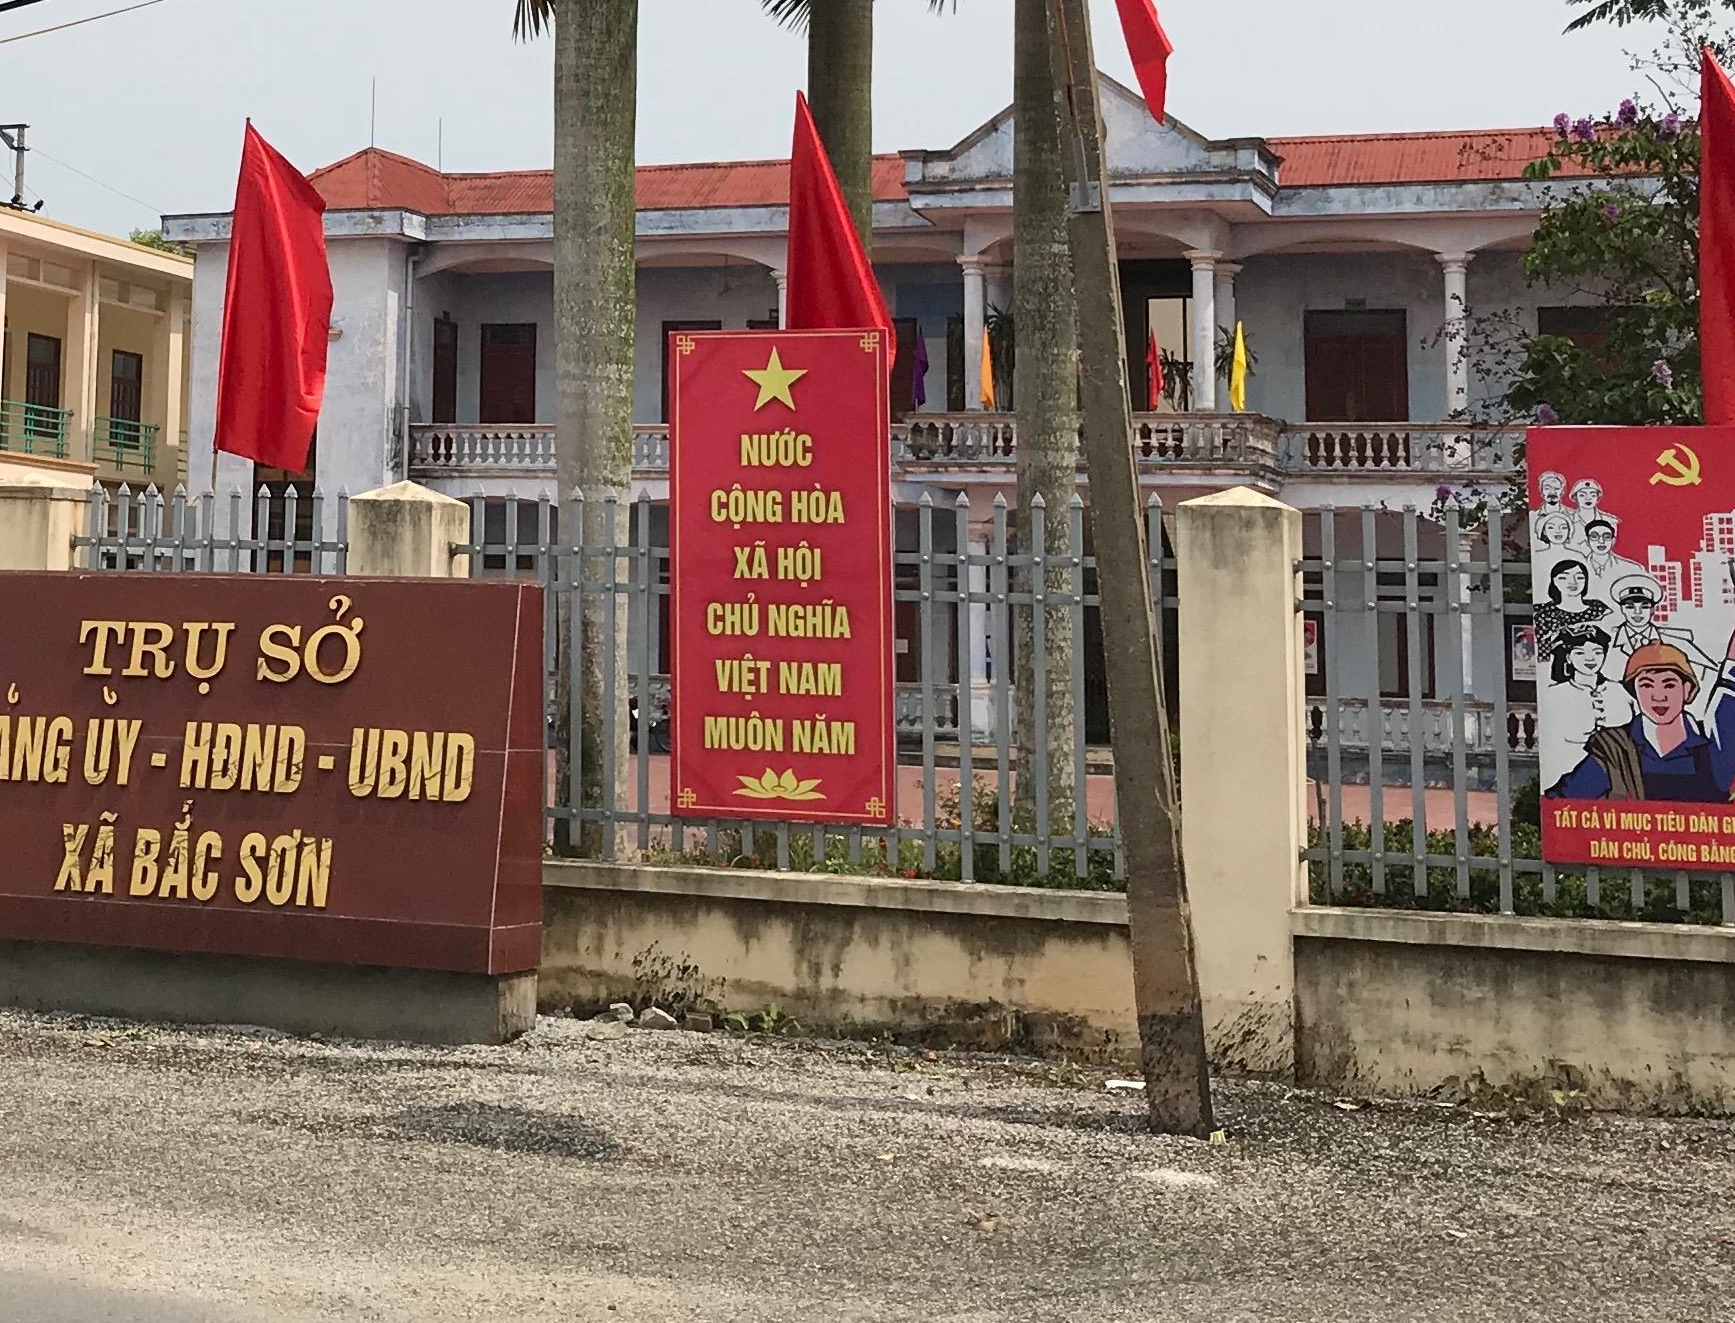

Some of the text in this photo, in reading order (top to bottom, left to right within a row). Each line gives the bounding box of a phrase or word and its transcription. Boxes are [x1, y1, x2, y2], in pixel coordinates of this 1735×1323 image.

[741, 428, 812, 466] NƯỚC
[710, 482, 845, 529] CỘNG HÒA
[734, 541, 821, 588] XÃ HỘI
[707, 592, 851, 639] CHỦ NGHĨA
[79, 594, 364, 695] TRỤ SỞ
[715, 653, 842, 701] VIỆT NAM
[704, 711, 856, 755] MUÔN NĂM
[150, 751, 166, 767] -
[180, 722, 305, 793] HĐND
[318, 755, 334, 770] -
[348, 728, 475, 802] UBND
[1554, 805, 1735, 834] TẤT CẢ VÌ MỤC TIÊU DÂN GI
[53, 798, 333, 908] XÃ BẮC SƠN
[1590, 837, 1619, 859] DÂN
[1623, 837, 1655, 862] CHỦ,
[1659, 840, 1697, 862] CÔNG
